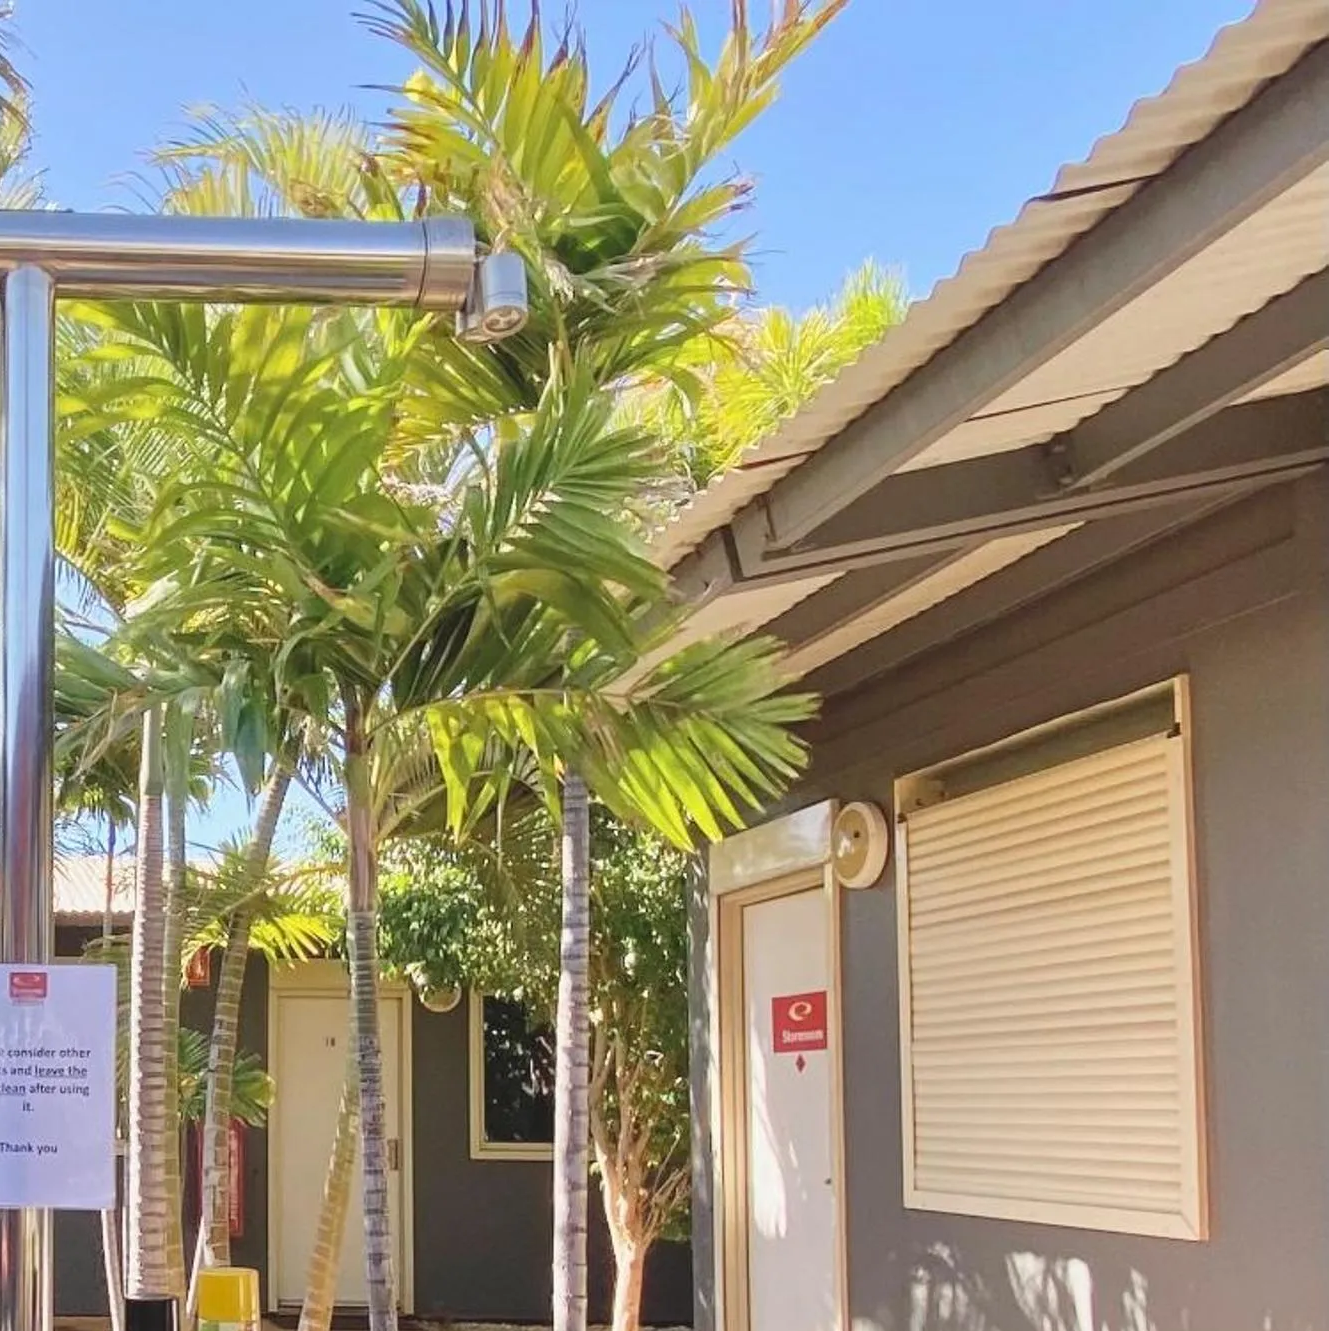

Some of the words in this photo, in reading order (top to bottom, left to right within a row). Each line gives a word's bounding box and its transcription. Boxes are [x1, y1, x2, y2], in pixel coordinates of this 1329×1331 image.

[7, 1046, 56, 1058] consider
[59, 1046, 92, 1058] other
[10, 1065, 33, 1076] and
[35, 1066, 65, 1077] leave
[67, 1066, 88, 1077] the
[29, 1084, 57, 1095] after
[59, 1084, 90, 1097] using
[22, 1102, 35, 1113] it.
[0, 1142, 34, 1154] Thank
[37, 1143, 58, 1156] you
